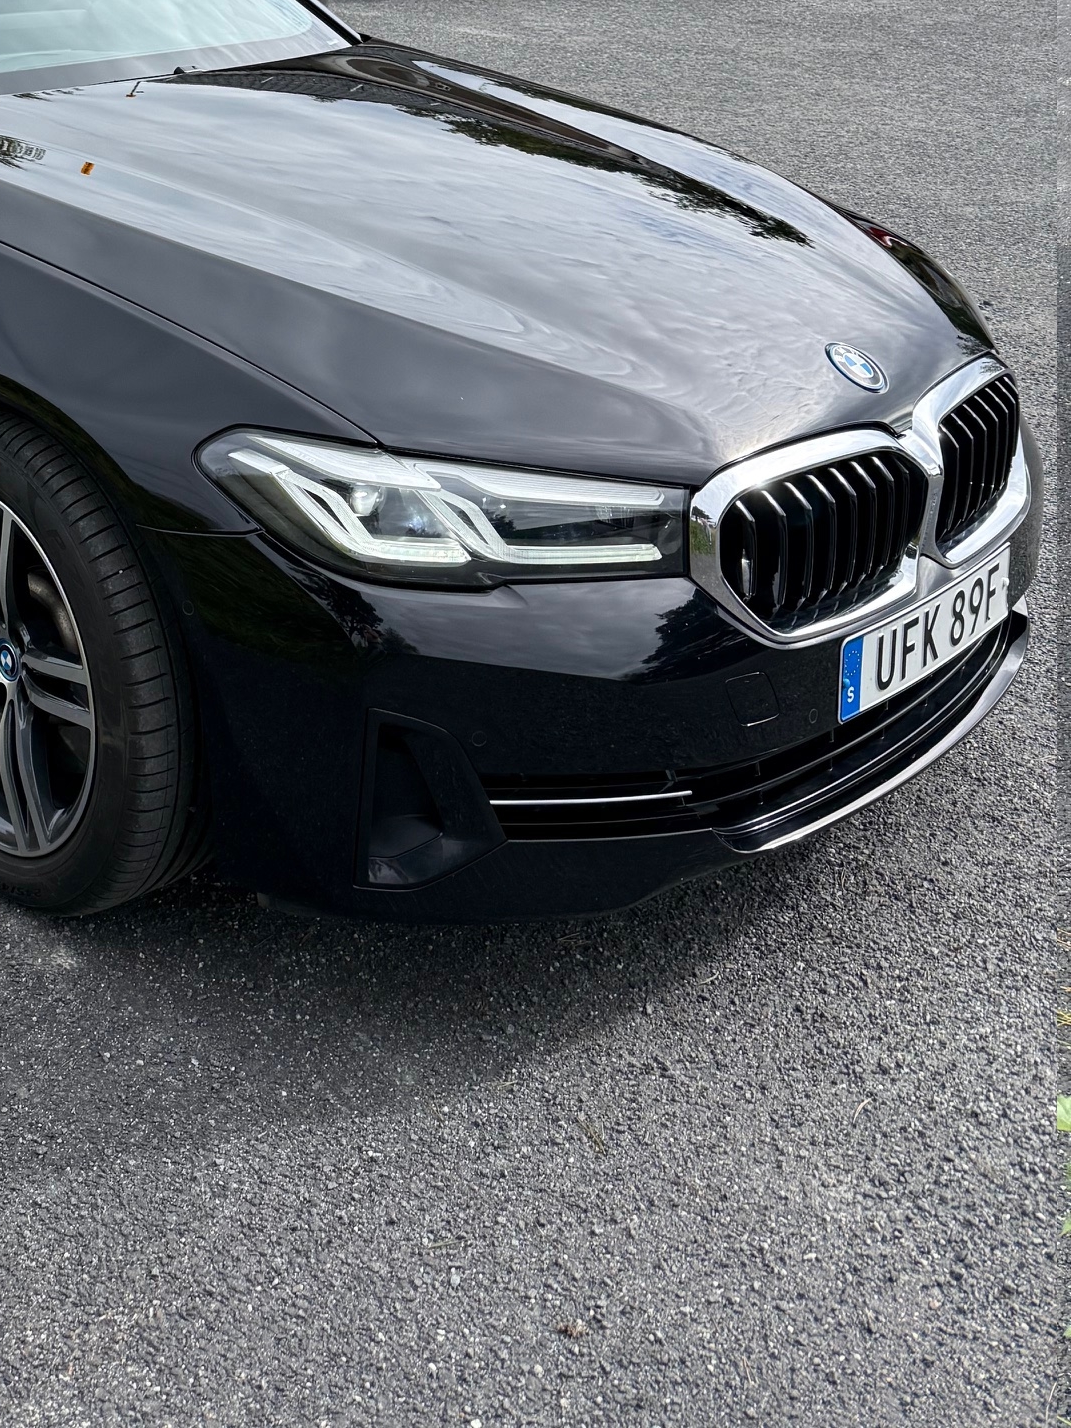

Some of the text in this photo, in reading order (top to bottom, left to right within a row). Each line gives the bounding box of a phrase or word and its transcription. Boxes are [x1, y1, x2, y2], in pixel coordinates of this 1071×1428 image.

[847, 561, 1000, 703] S UFK 89F
